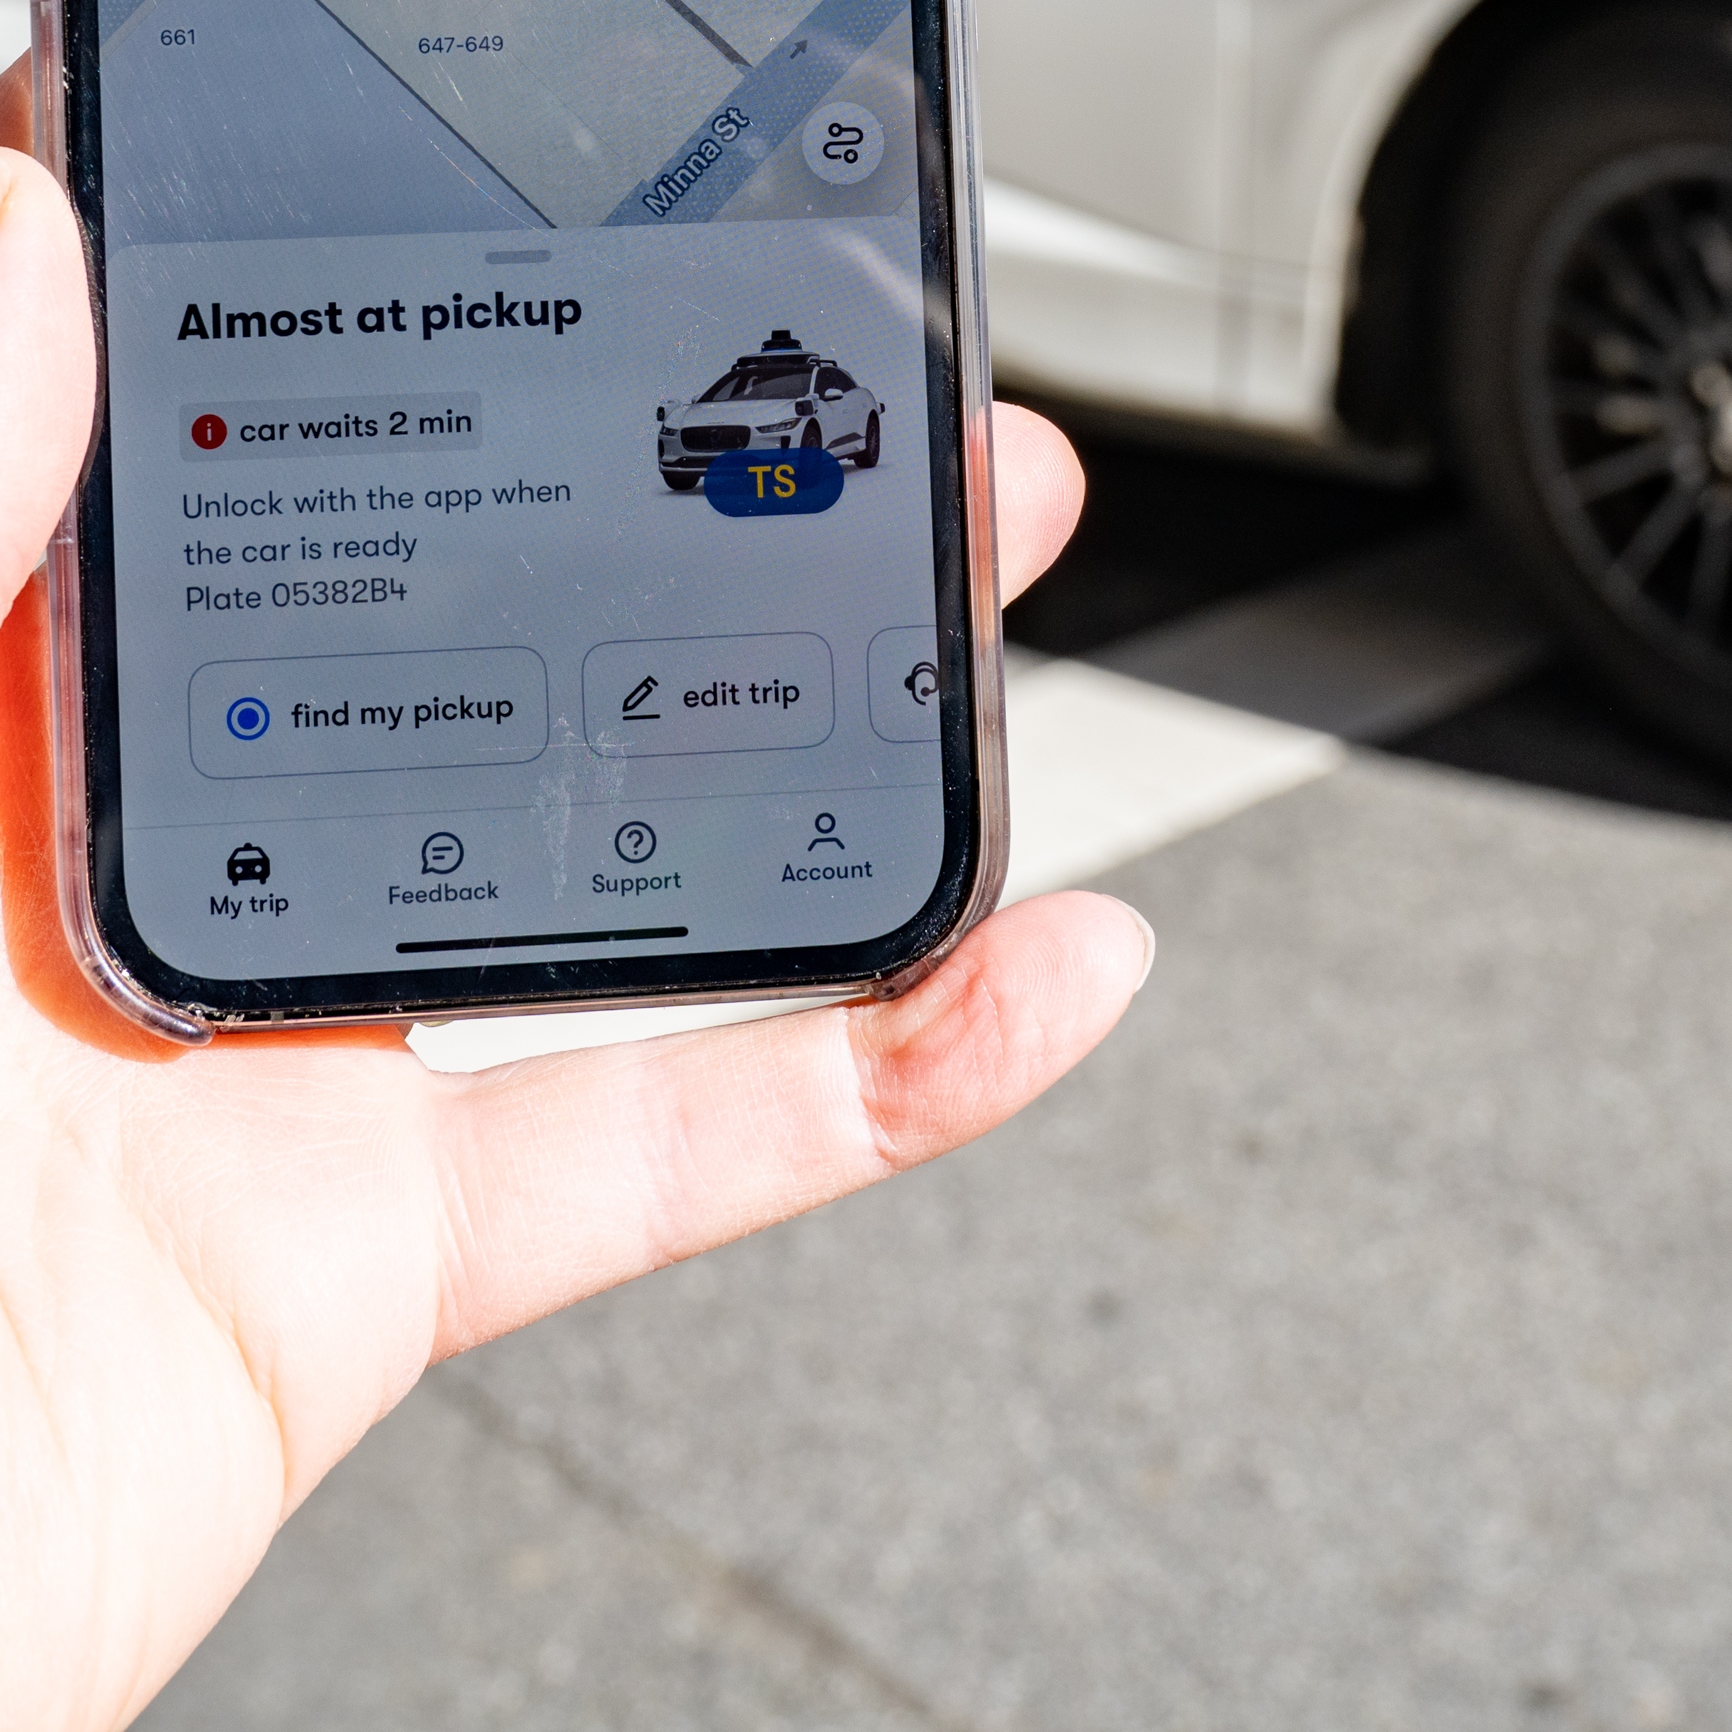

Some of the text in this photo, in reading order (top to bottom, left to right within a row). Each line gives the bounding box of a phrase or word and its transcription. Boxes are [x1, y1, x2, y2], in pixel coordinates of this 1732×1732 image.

[160, 28, 195, 46] 661
[418, 35, 504, 55] 647-649
[643, 107, 750, 217] Minna St
[176, 291, 582, 341] Almost at pickup
[239, 408, 472, 443] car waits 2 min
[183, 478, 571, 520] Unlock with the app when
[747, 464, 796, 499] TS
[183, 530, 418, 566] the car is ready
[186, 577, 408, 612] Plate 05382B4
[683, 678, 800, 710] edit trip
[290, 694, 514, 732] find my pickup
[592, 871, 682, 897] Support
[781, 861, 873, 883] Account
[210, 892, 289, 920] My trip
[388, 880, 499, 905] Feedback
